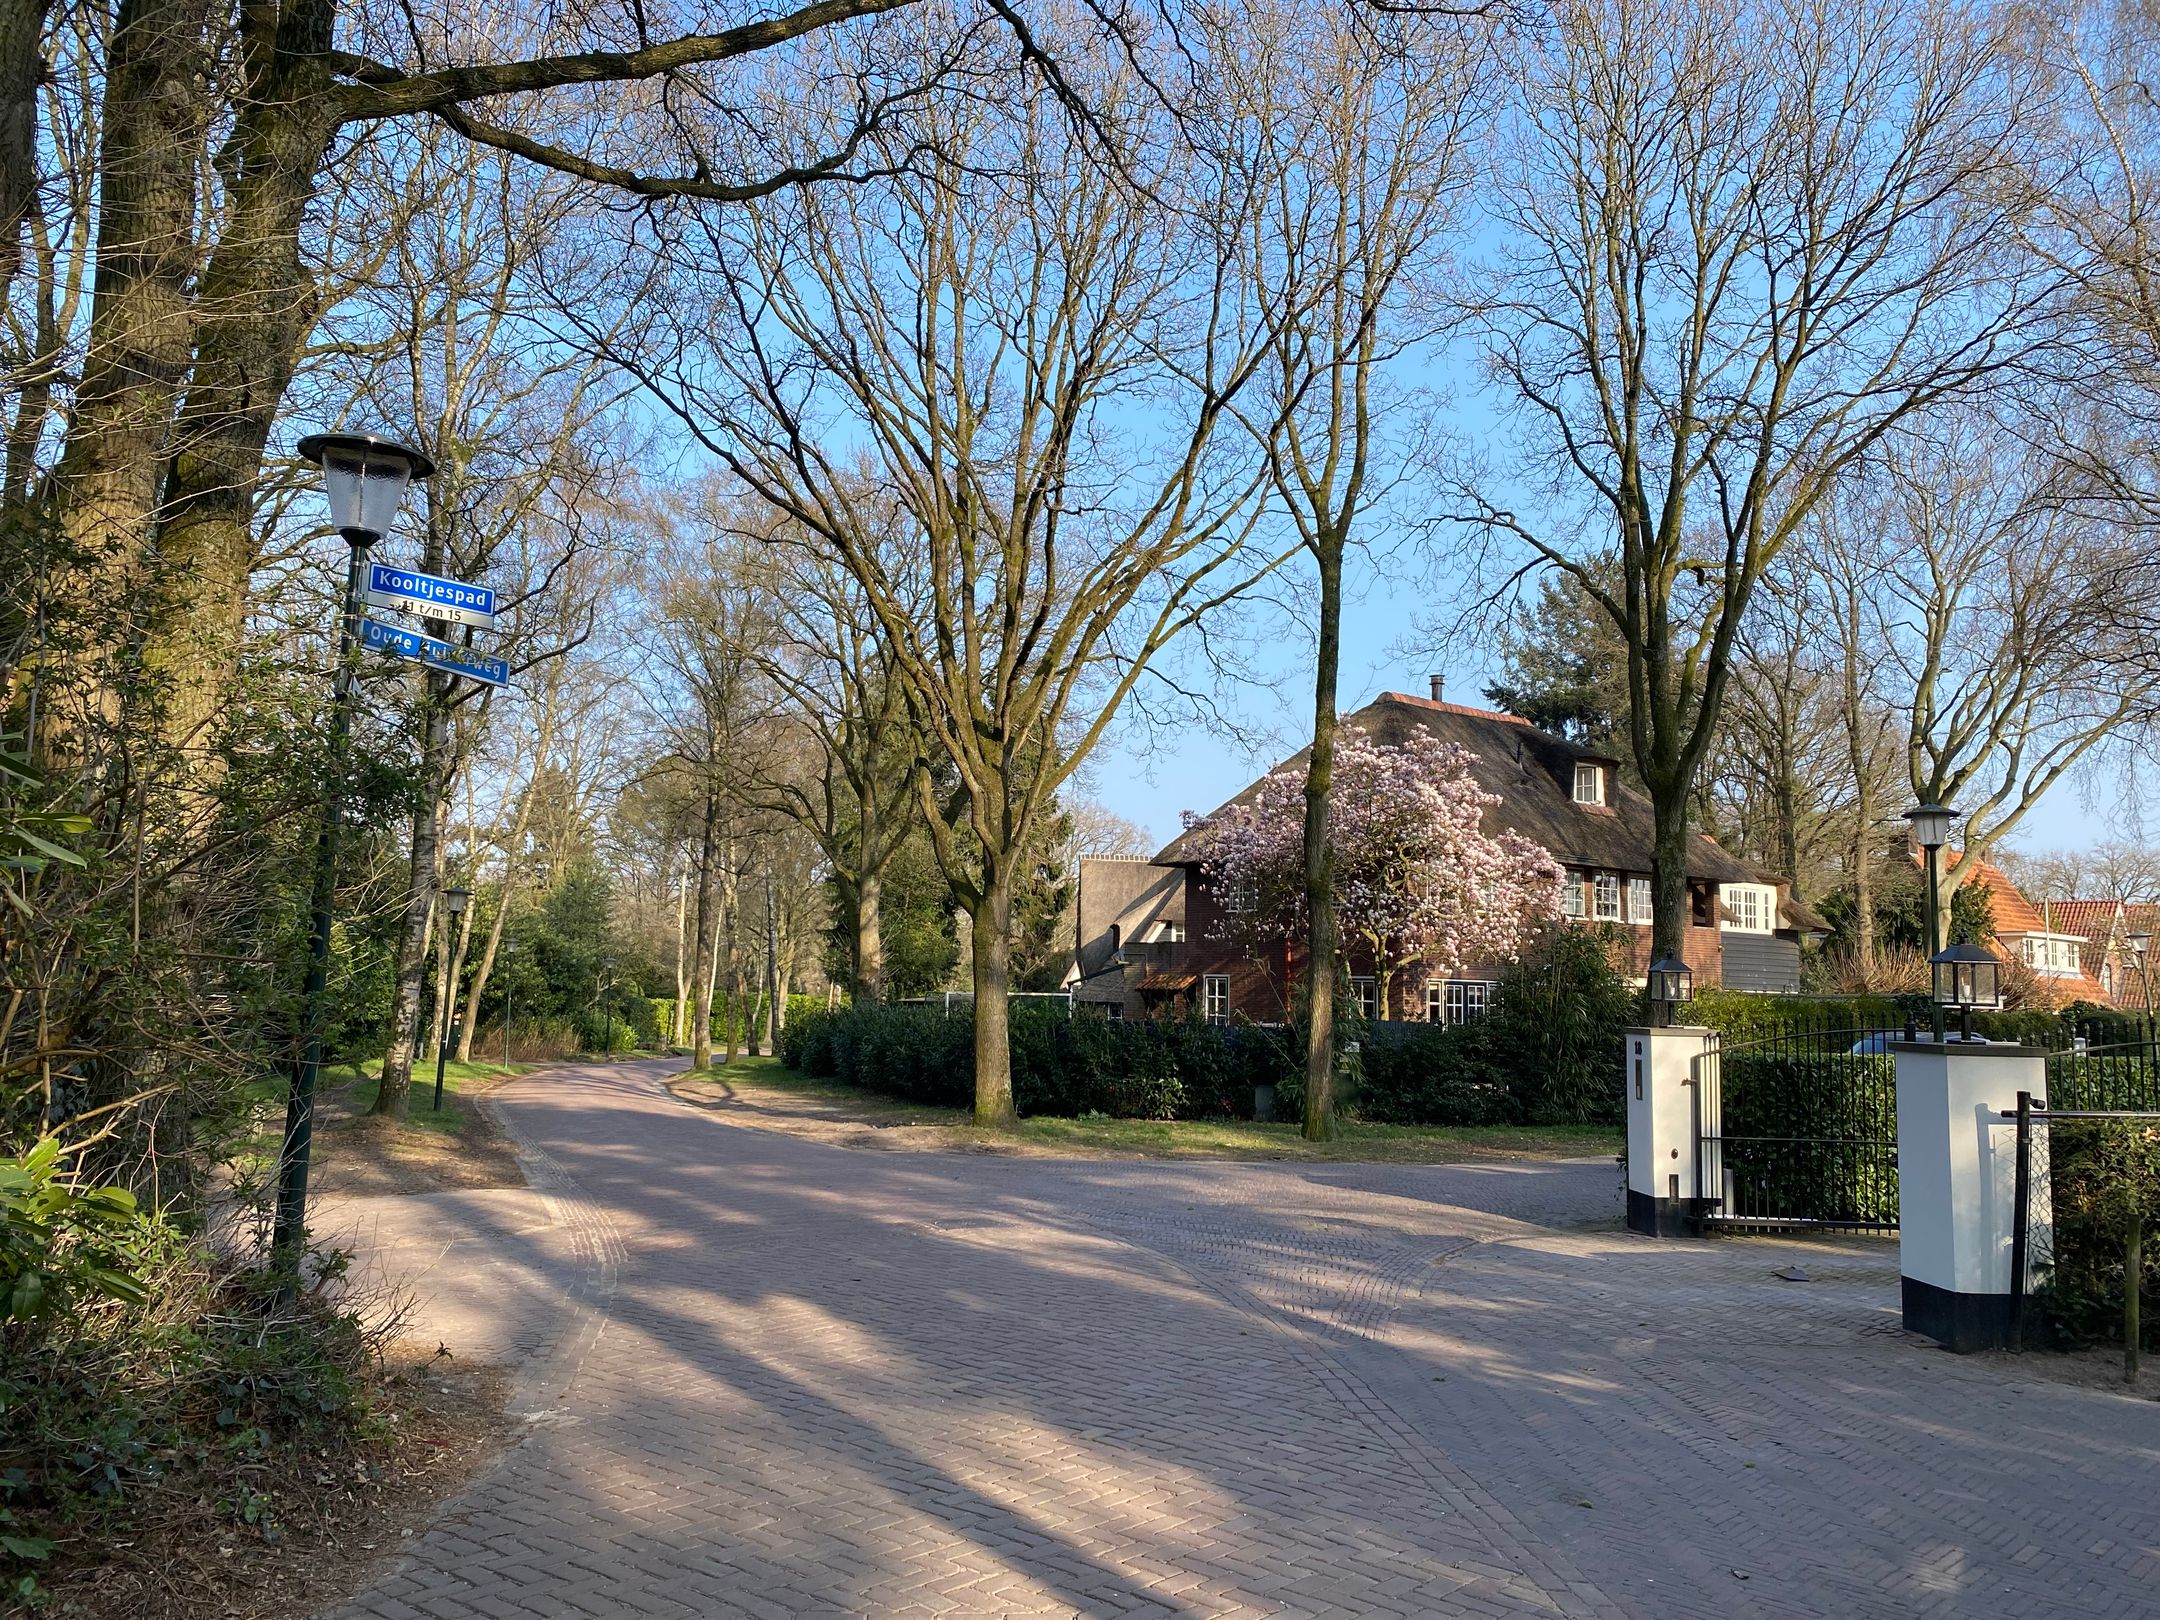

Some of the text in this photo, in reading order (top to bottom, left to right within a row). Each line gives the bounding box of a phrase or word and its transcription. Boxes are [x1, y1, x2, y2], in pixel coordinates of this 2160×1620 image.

[380, 570, 486, 605] Kooltjespad
[419, 604, 443, 618] t/m
[448, 609, 462, 621] 15
[371, 626, 412, 649] Oude
